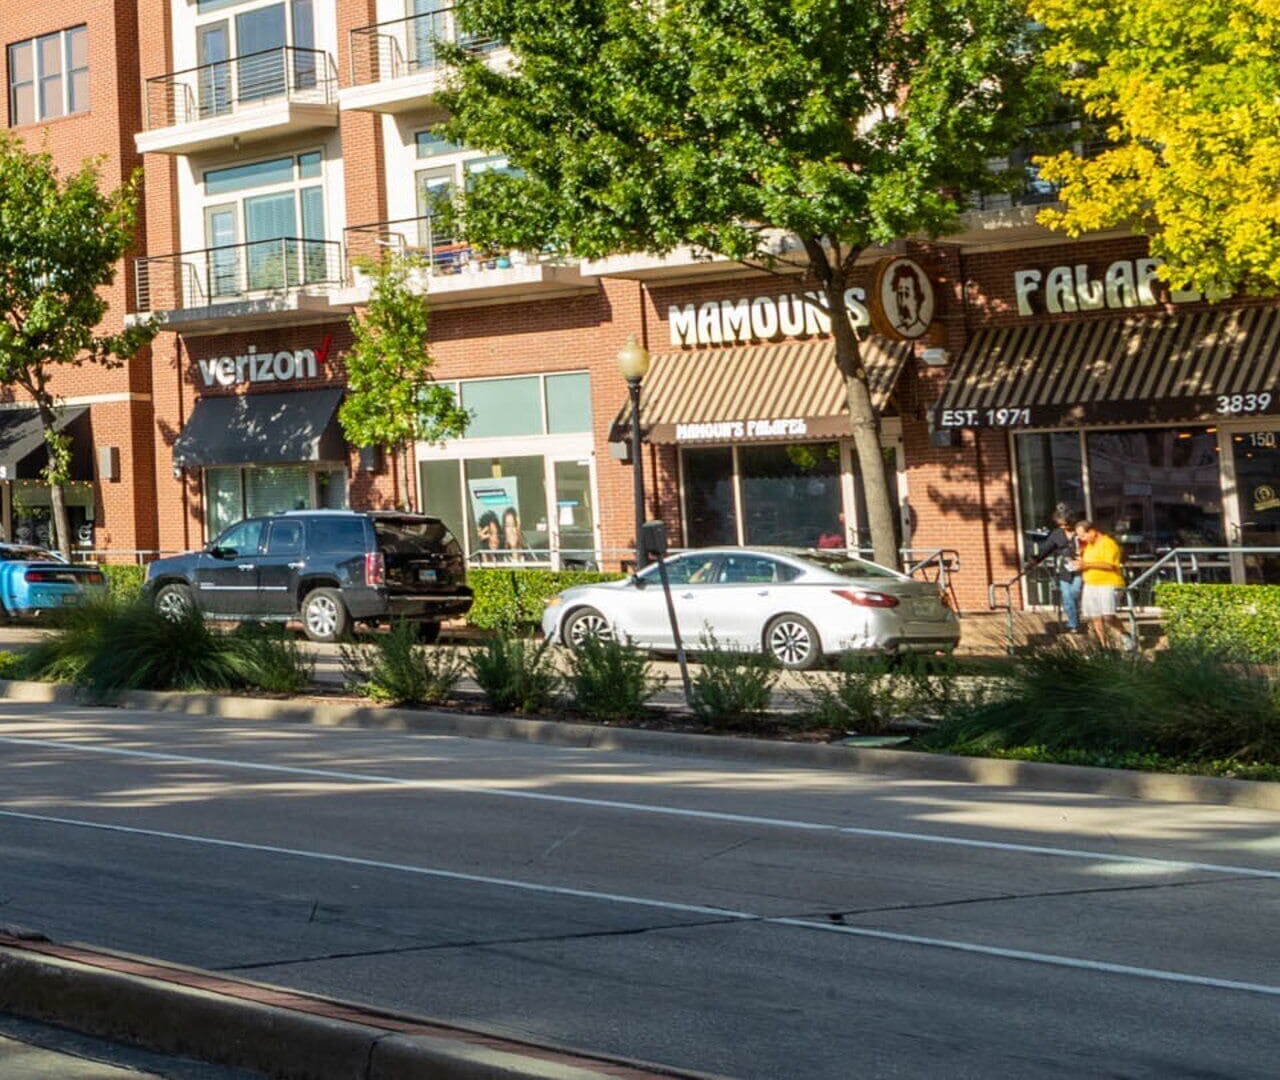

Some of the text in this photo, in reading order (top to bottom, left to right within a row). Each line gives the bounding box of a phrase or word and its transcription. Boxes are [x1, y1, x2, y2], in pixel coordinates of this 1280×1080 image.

[1014, 258, 1232, 316] FALAF
[668, 287, 870, 346] MAMOUNS
[198, 345, 317, 386] verizon
[941, 408, 1031, 426] EST. 1971
[1216, 393, 1272, 414] 3839
[1249, 432, 1276, 447] 150
